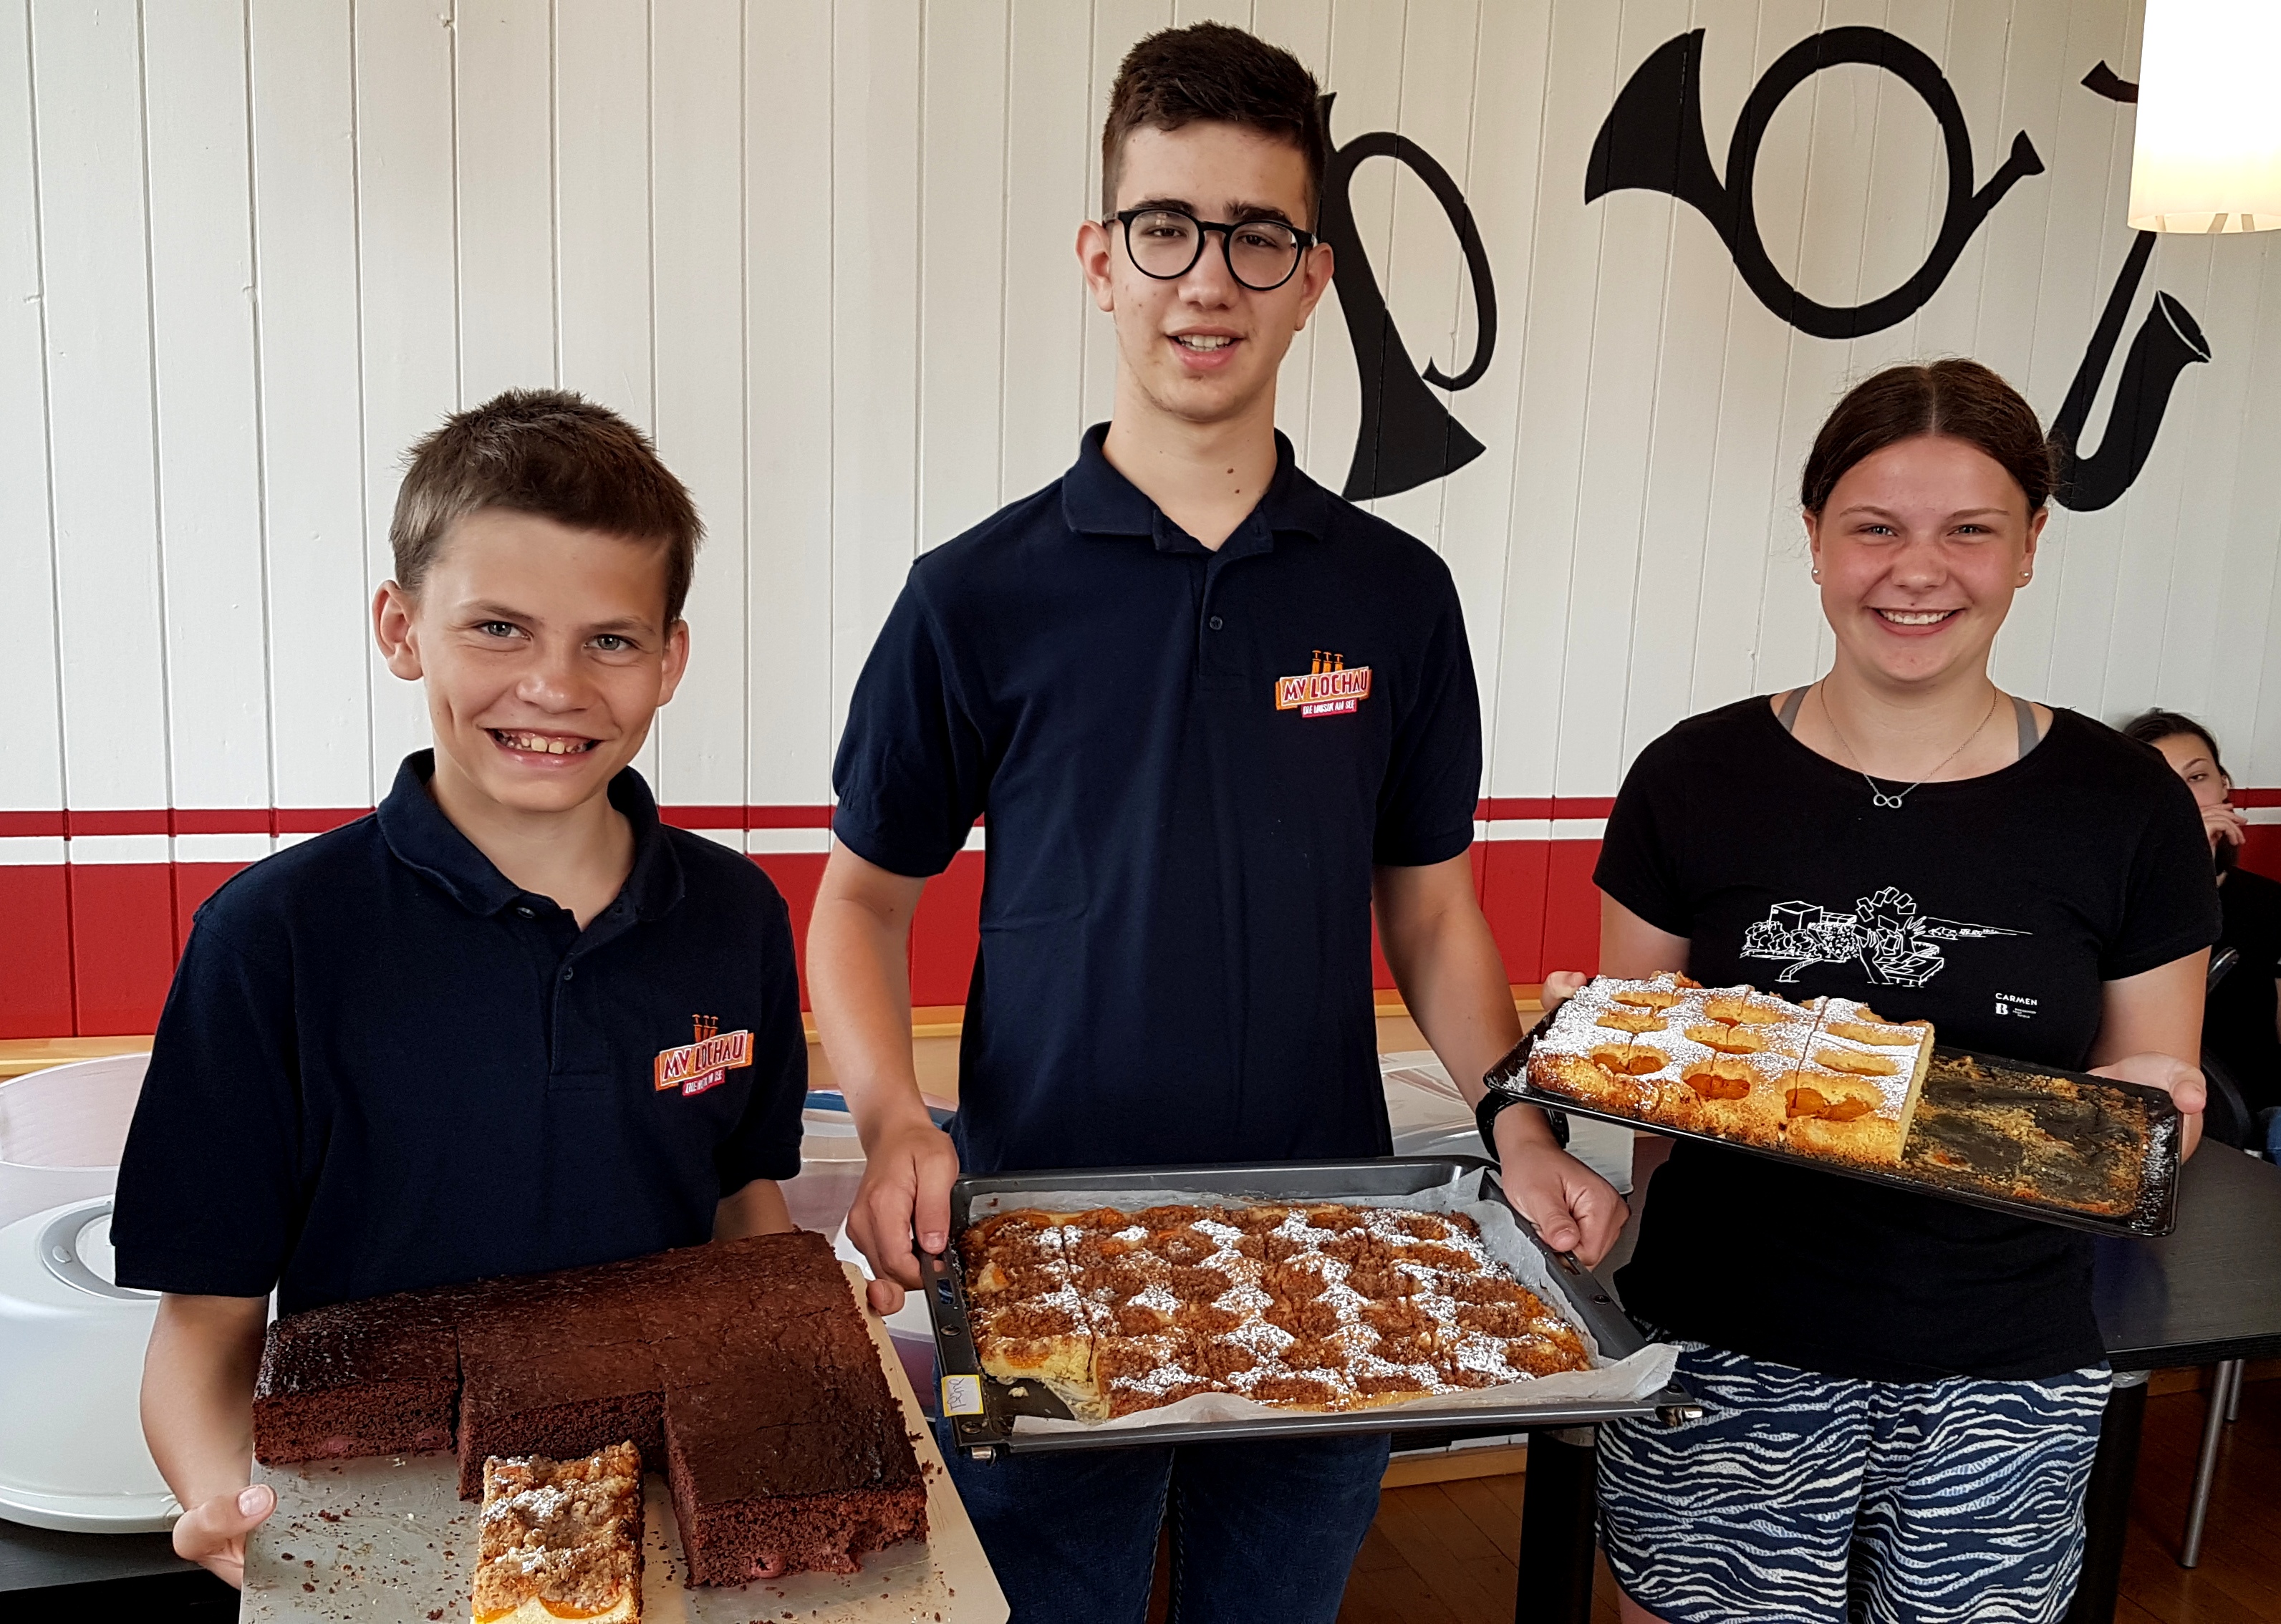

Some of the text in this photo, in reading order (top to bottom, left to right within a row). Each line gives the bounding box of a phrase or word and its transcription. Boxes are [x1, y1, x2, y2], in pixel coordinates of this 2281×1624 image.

[1283, 669, 1369, 702] MV LOCHAU
[1995, 992, 2038, 1006] CARMEN
[662, 1048, 692, 1081] MV
[693, 1033, 746, 1073] LOCHAU
